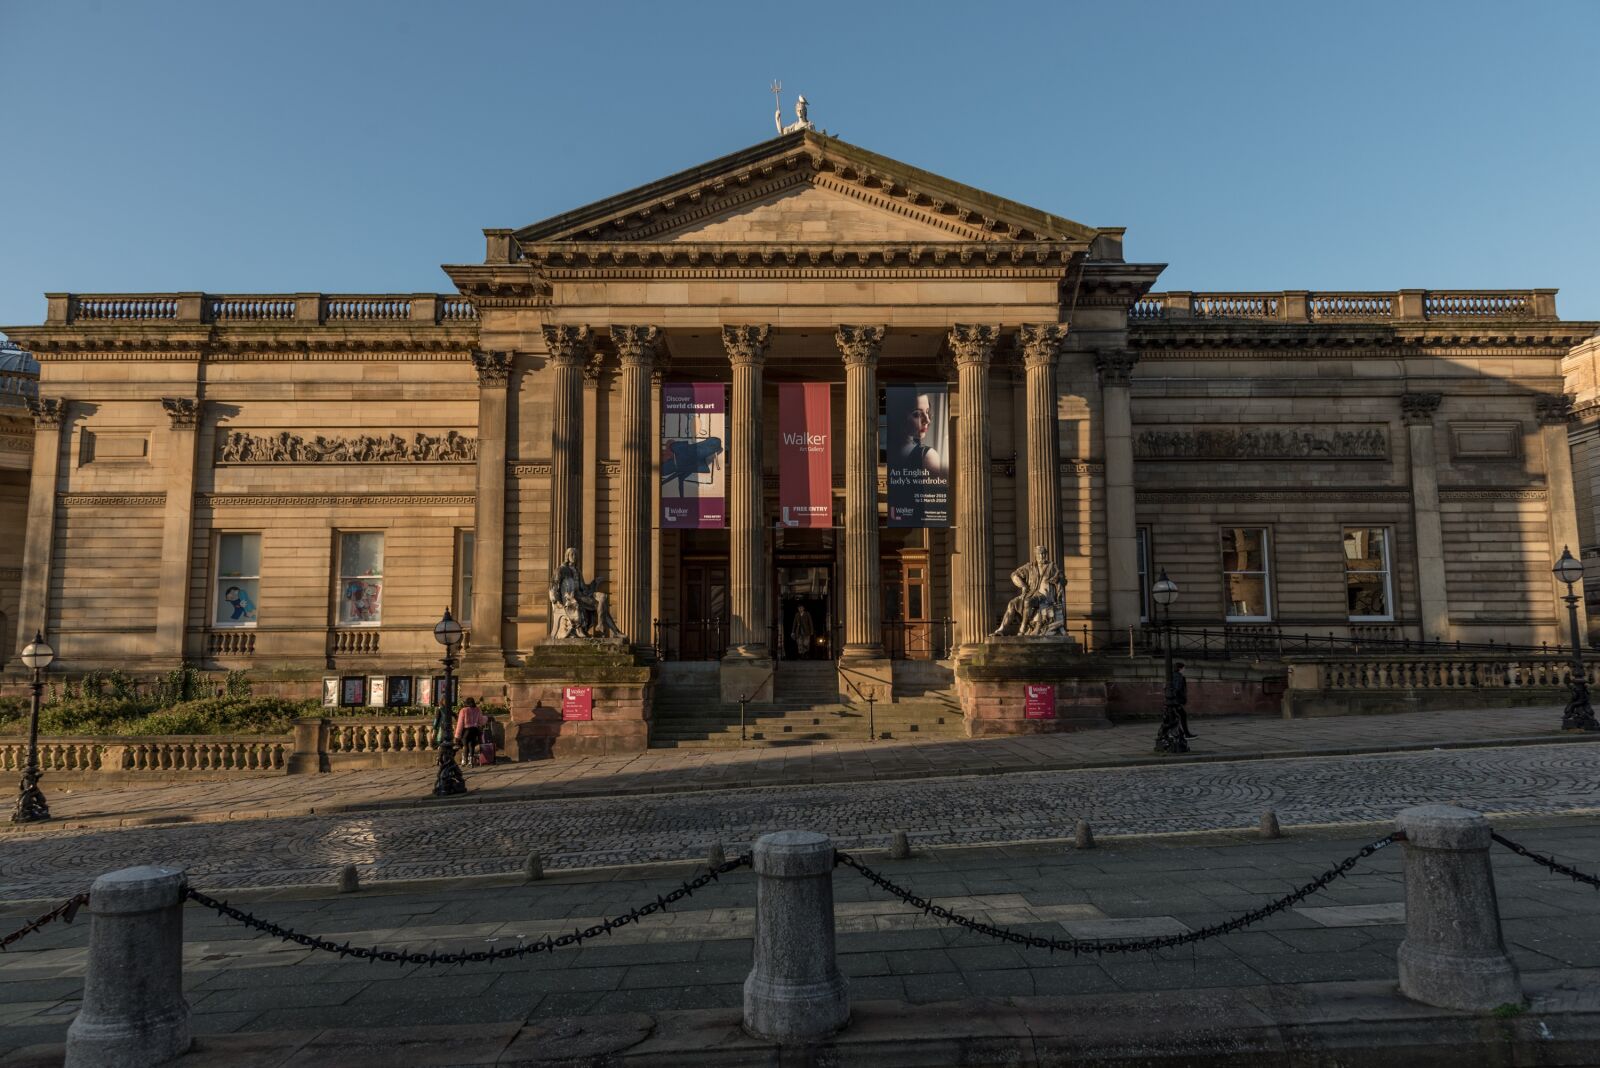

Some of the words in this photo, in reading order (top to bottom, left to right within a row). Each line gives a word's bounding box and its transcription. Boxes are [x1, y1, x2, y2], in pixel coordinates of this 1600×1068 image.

[783, 432, 827, 445] Walker
[890, 468, 901, 476] An
[903, 468, 930, 477] English
[890, 477, 911, 485] lady's
[912, 477, 947, 485] wardrobe
